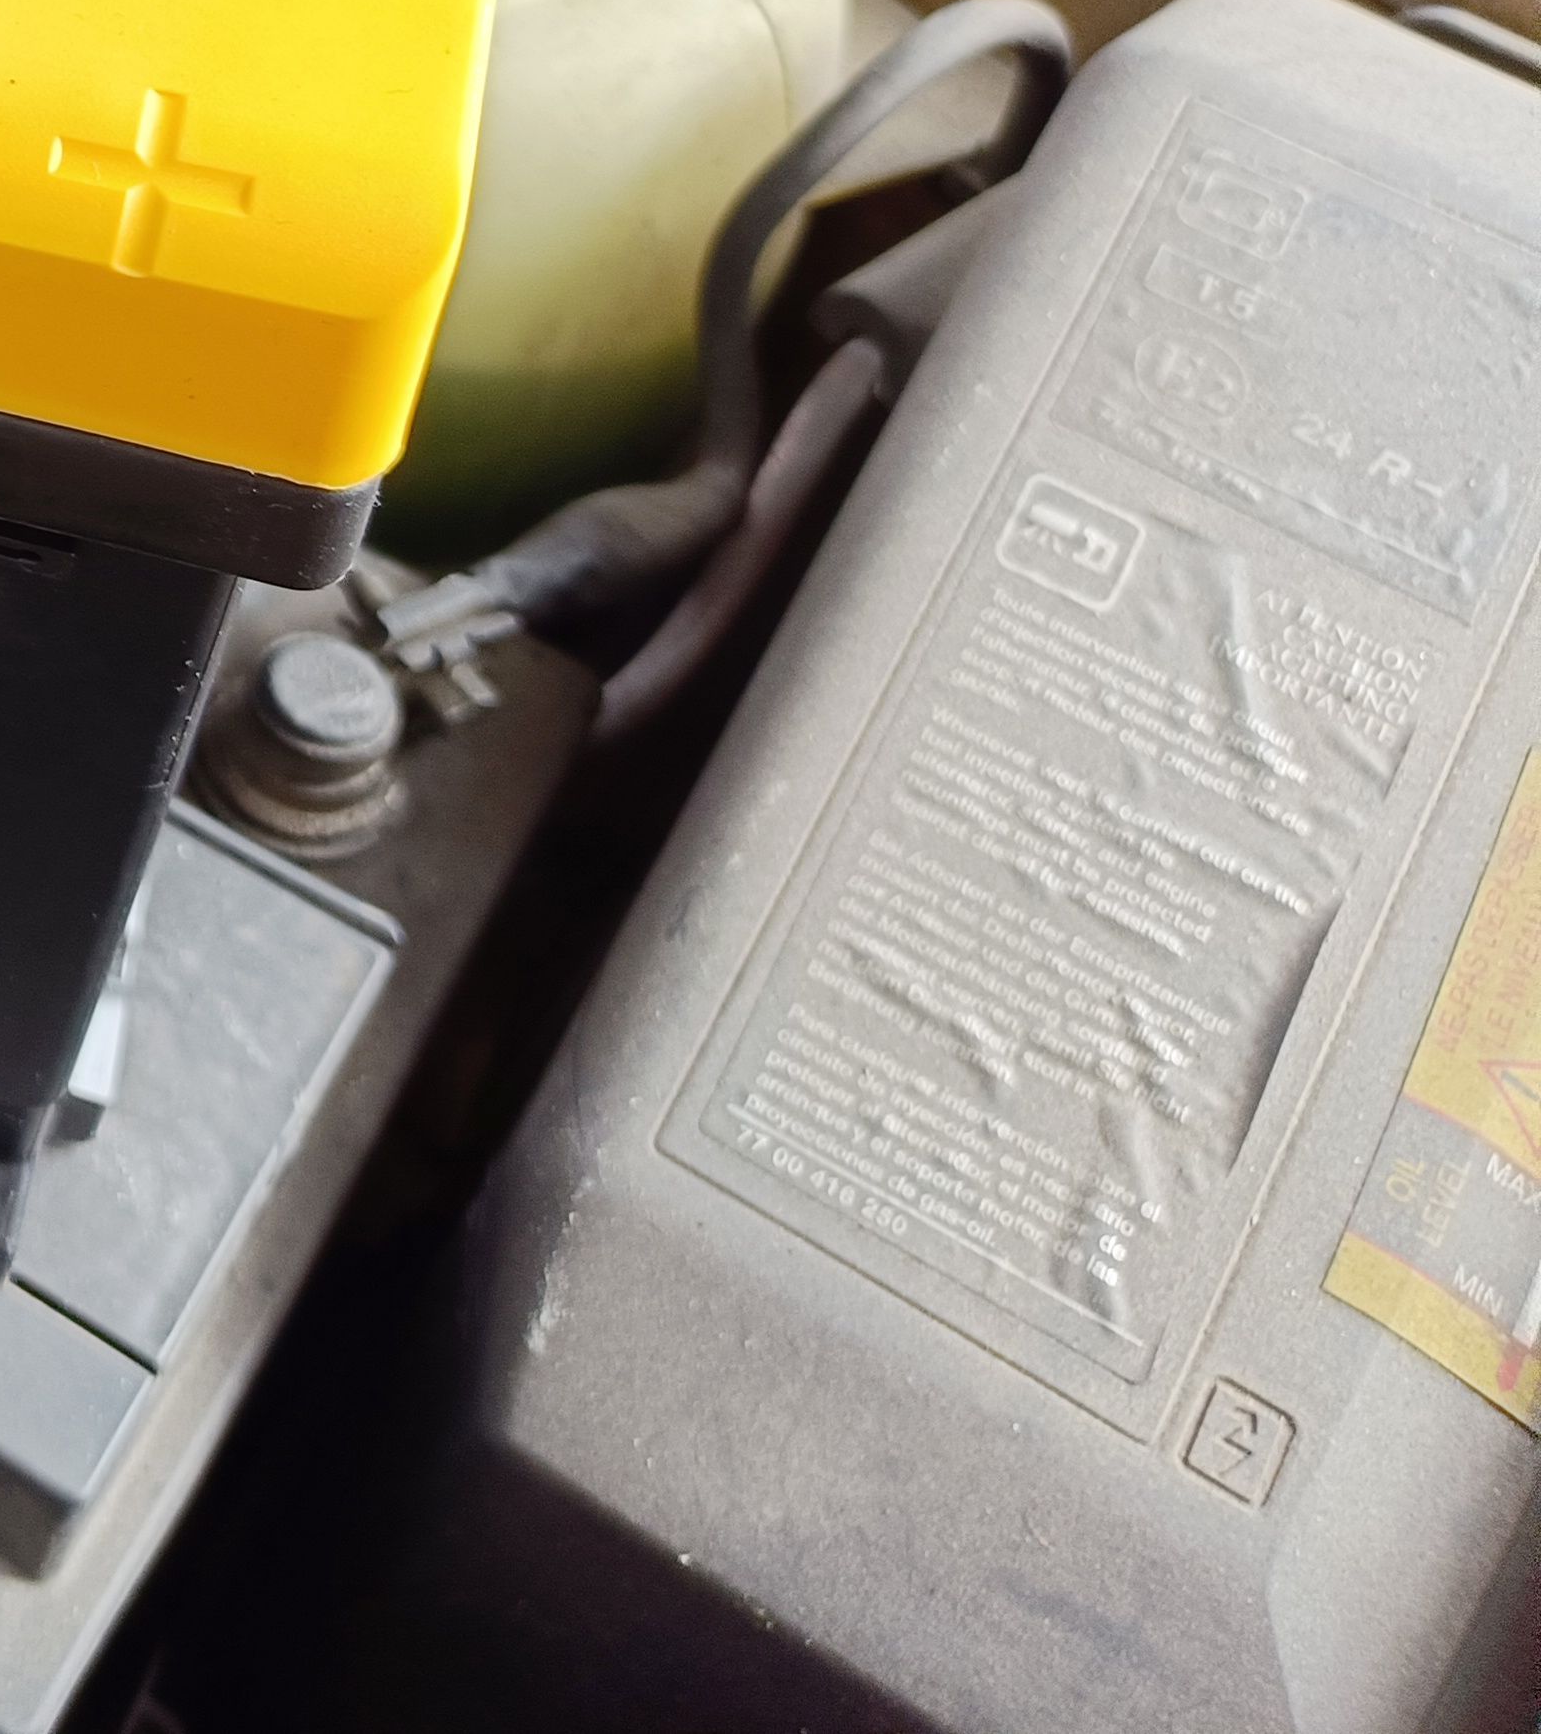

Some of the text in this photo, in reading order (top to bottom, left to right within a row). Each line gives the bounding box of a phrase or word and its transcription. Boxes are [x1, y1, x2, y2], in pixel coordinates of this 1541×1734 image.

[1287, 407, 1358, 463] 24
[1255, 583, 1427, 684] ATTENTION
[1279, 622, 1420, 707] CAUTION
[732, 1121, 770, 1157] 77
[767, 1142, 809, 1181] 00
[806, 1164, 860, 1209] 416
[1385, 1148, 1426, 1204] OIL
[1416, 1152, 1472, 1249] LEVEL
[1450, 1262, 1506, 1318] MIN
